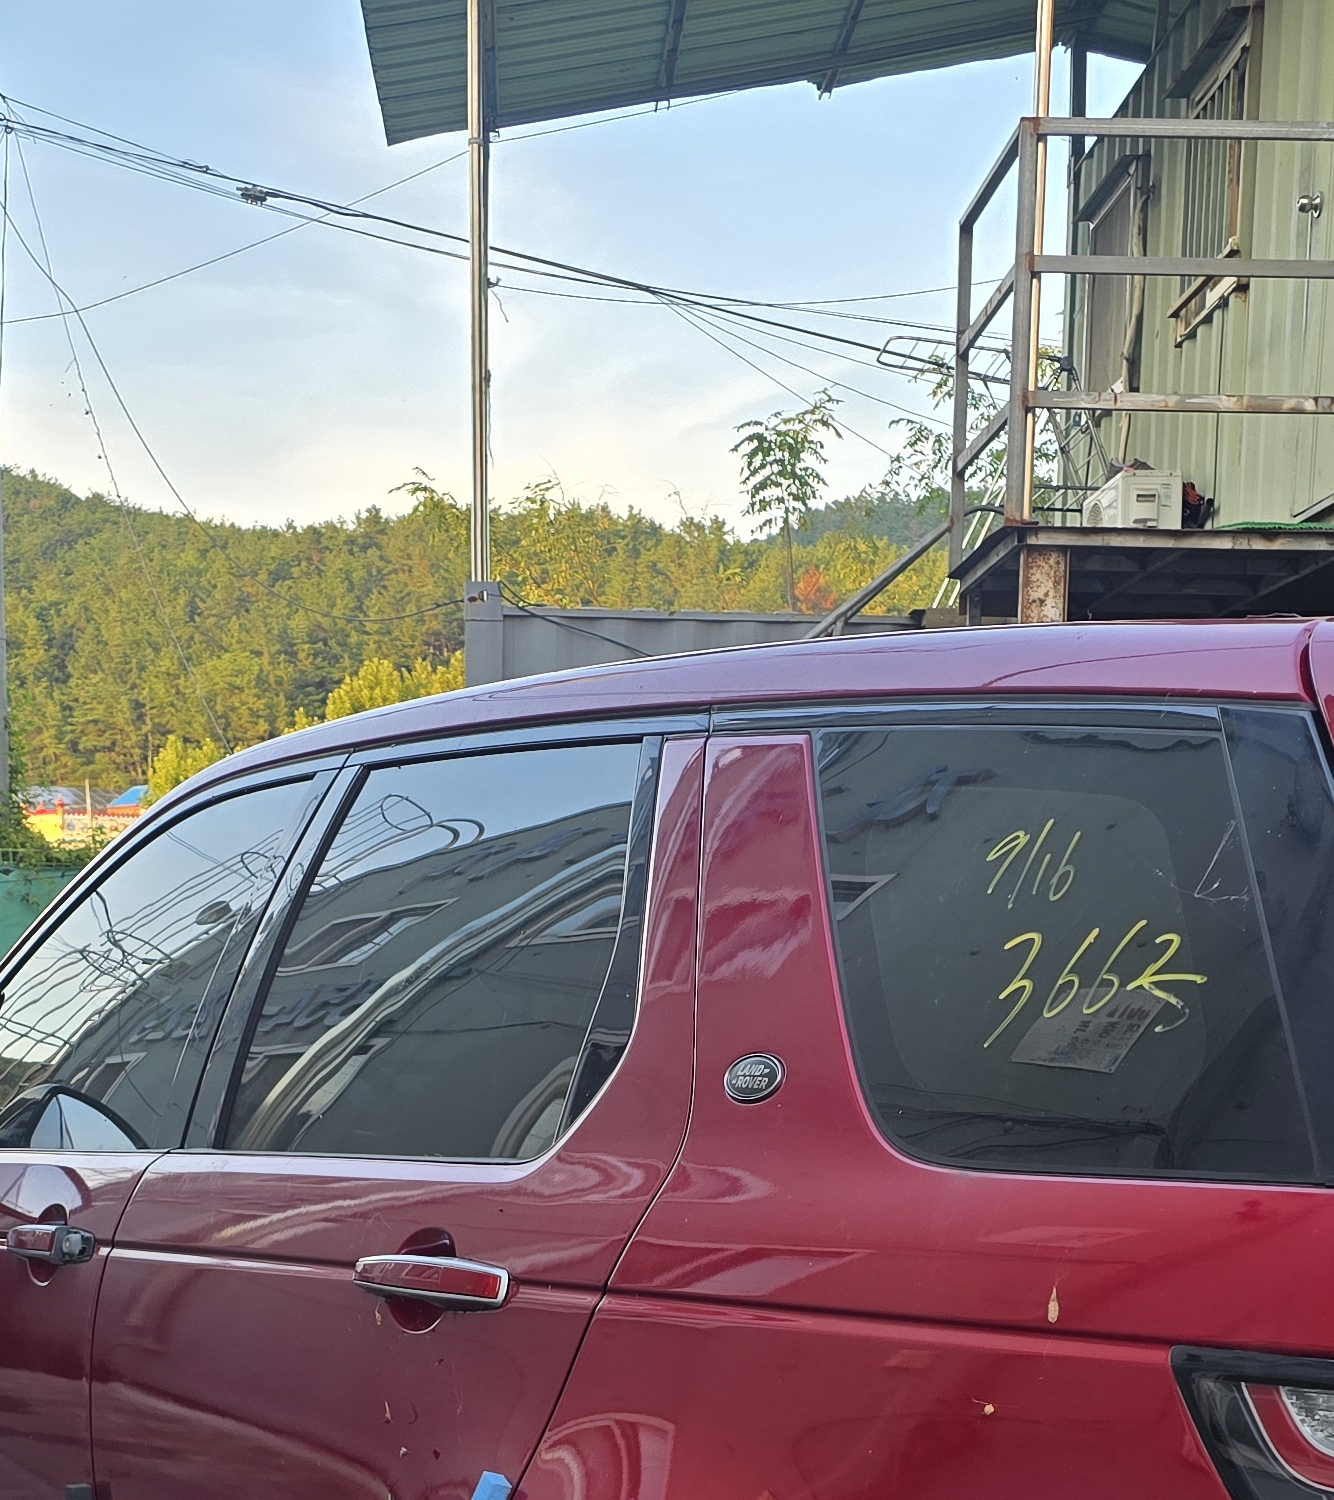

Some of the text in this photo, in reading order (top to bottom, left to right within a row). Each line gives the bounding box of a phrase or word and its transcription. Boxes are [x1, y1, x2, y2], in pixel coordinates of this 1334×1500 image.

[986, 818, 1081, 909] 9/16
[736, 1063, 765, 1076] LAND
[734, 1076, 769, 1090] ROVER
